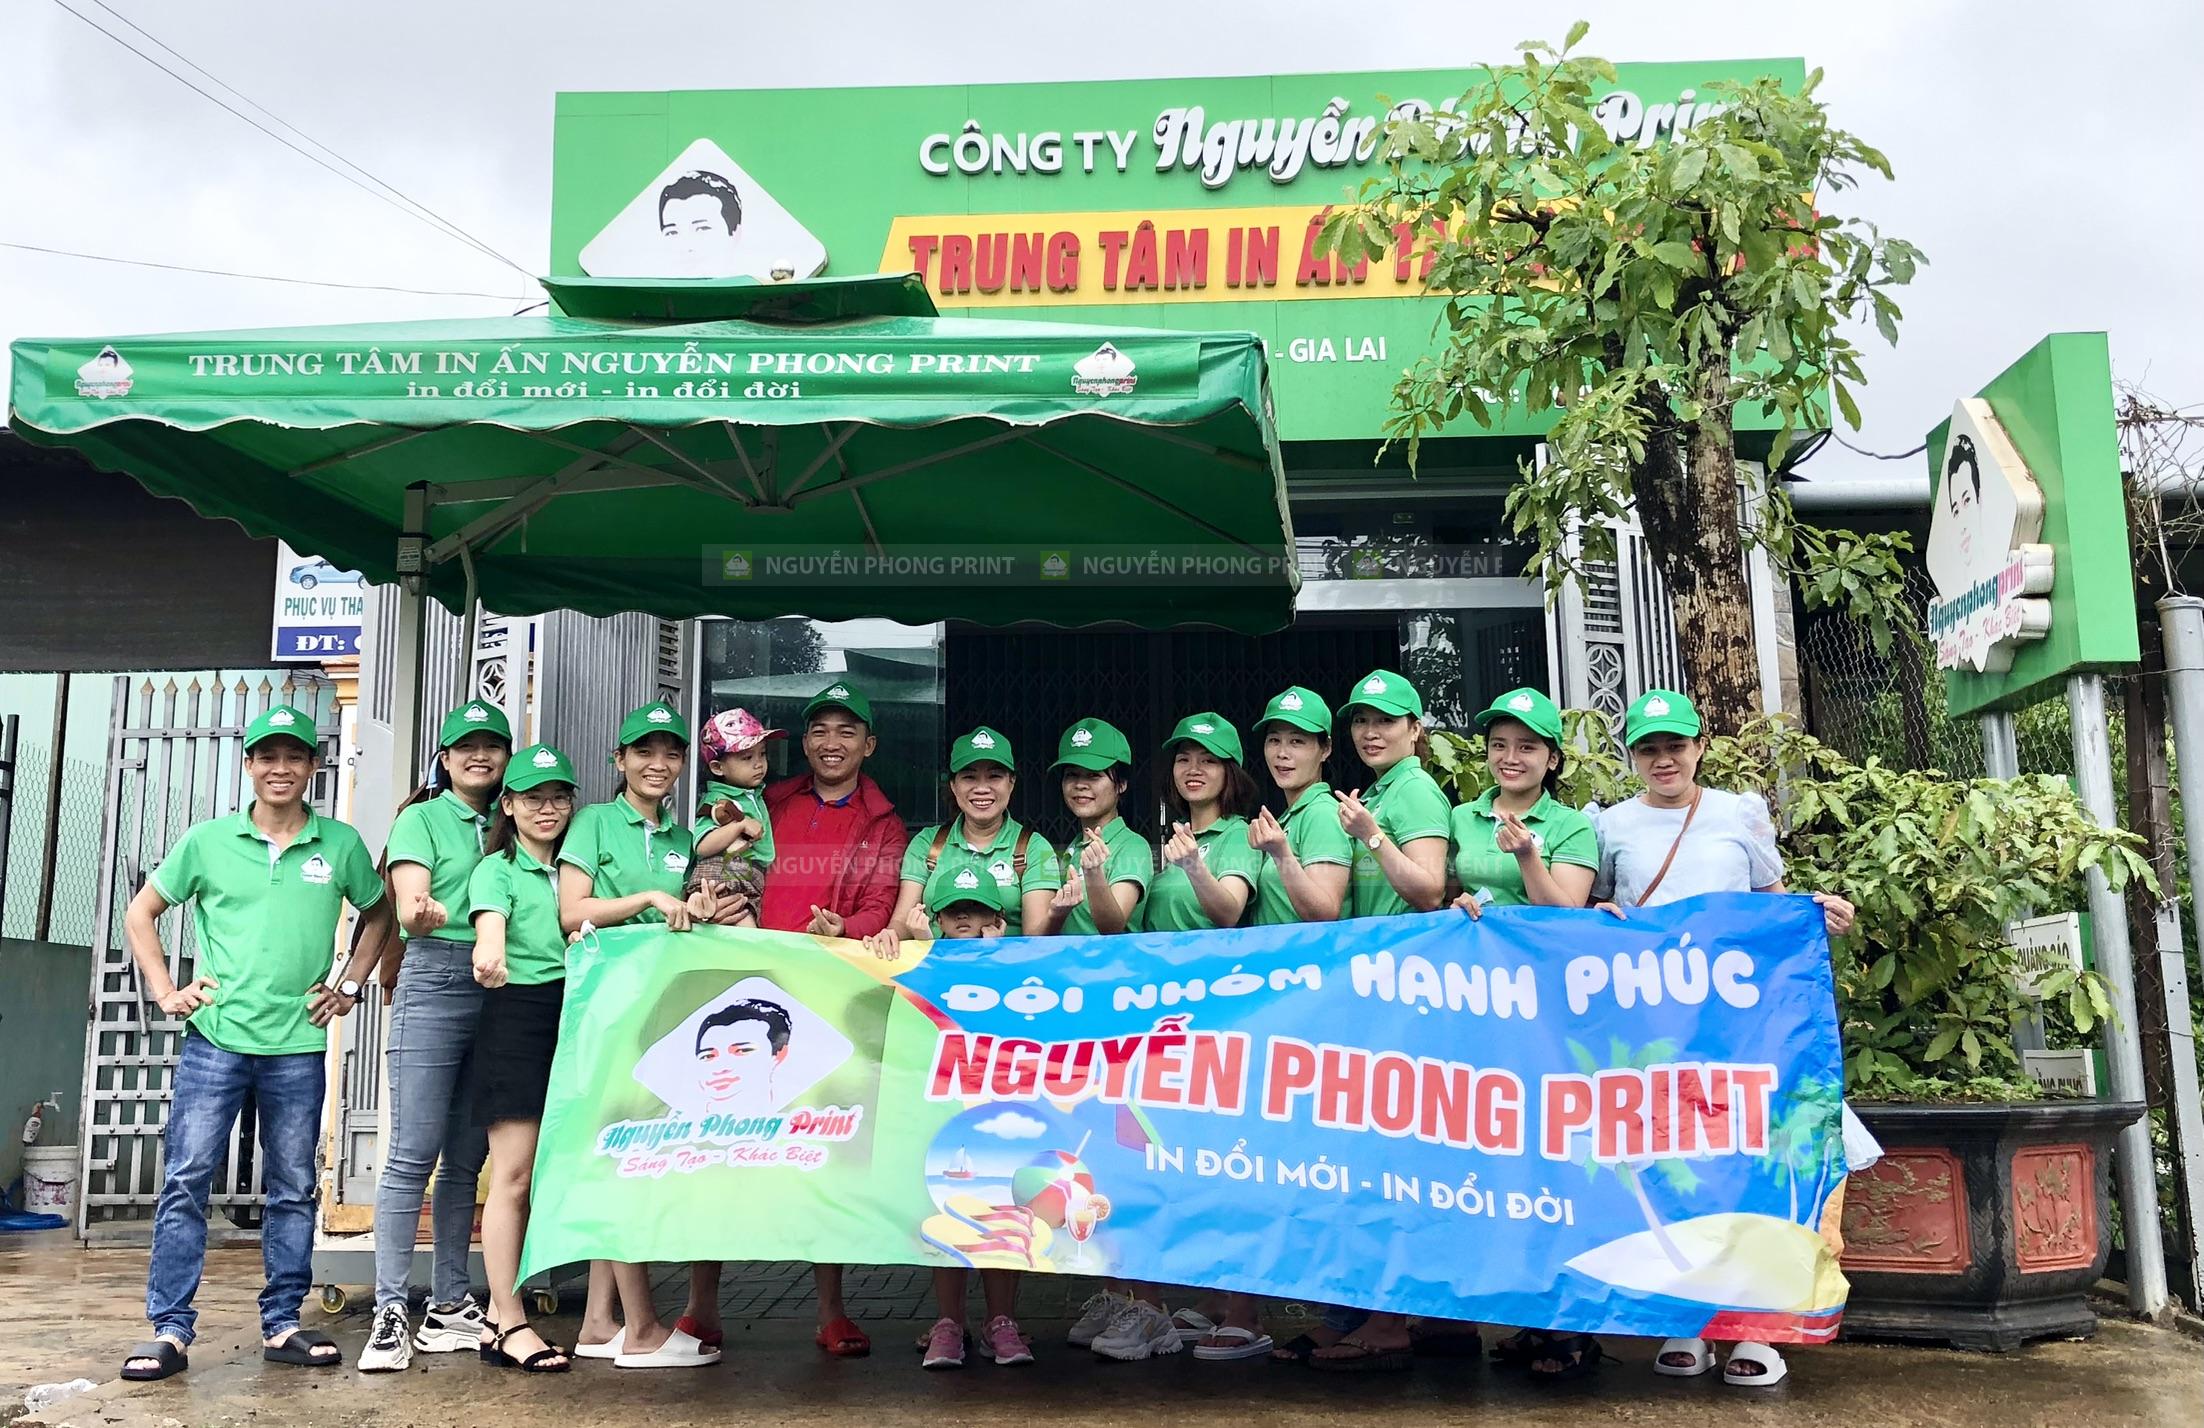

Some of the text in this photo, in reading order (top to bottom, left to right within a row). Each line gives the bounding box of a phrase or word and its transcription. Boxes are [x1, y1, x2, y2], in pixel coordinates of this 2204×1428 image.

[919, 119, 1062, 176] CÔNG
[1073, 129, 1138, 173] TY
[1153, 96, 1376, 189] Nguyễn
[908, 231, 1080, 294] TRUNG
[1099, 219, 1208, 291] TÂM
[1227, 225, 1279, 287] IN
[189, 342, 1040, 376] TRUNG TÂM IN ẤN NGUYỄN PHONG PRINT
[1289, 338, 1336, 362] GIA
[1345, 336, 1386, 361] LAI
[407, 382, 440, 398] in
[453, 379, 509, 398] đổi
[521, 382, 591, 398] mới
[625, 382, 661, 398] in
[673, 379, 728, 398] đổi
[744, 382, 802, 398] đời
[284, 597, 317, 620] PHỤC
[321, 597, 337, 620] VỤ
[296, 634, 345, 651] ĐT:
[941, 931, 1760, 1021] ĐỘI NHÓM HẠNH PHÚC
[931, 1016, 1771, 1157] NGUYỄN PHONG PRINT
[698, 1113, 783, 1139] Phong
[789, 1108, 856, 1137] Print
[623, 1156, 668, 1174] Sáng
[678, 1150, 707, 1170] Tạo
[732, 1147, 778, 1163] Khác
[1145, 1143, 1184, 1174] IN
[1195, 1138, 1264, 1183] ĐỔI
[1277, 1155, 1349, 1193] MỚI
[1383, 1172, 1421, 1205] IN
[1429, 1172, 1496, 1217] ĐỔI
[1505, 1193, 1575, 1226] ĐỜI
